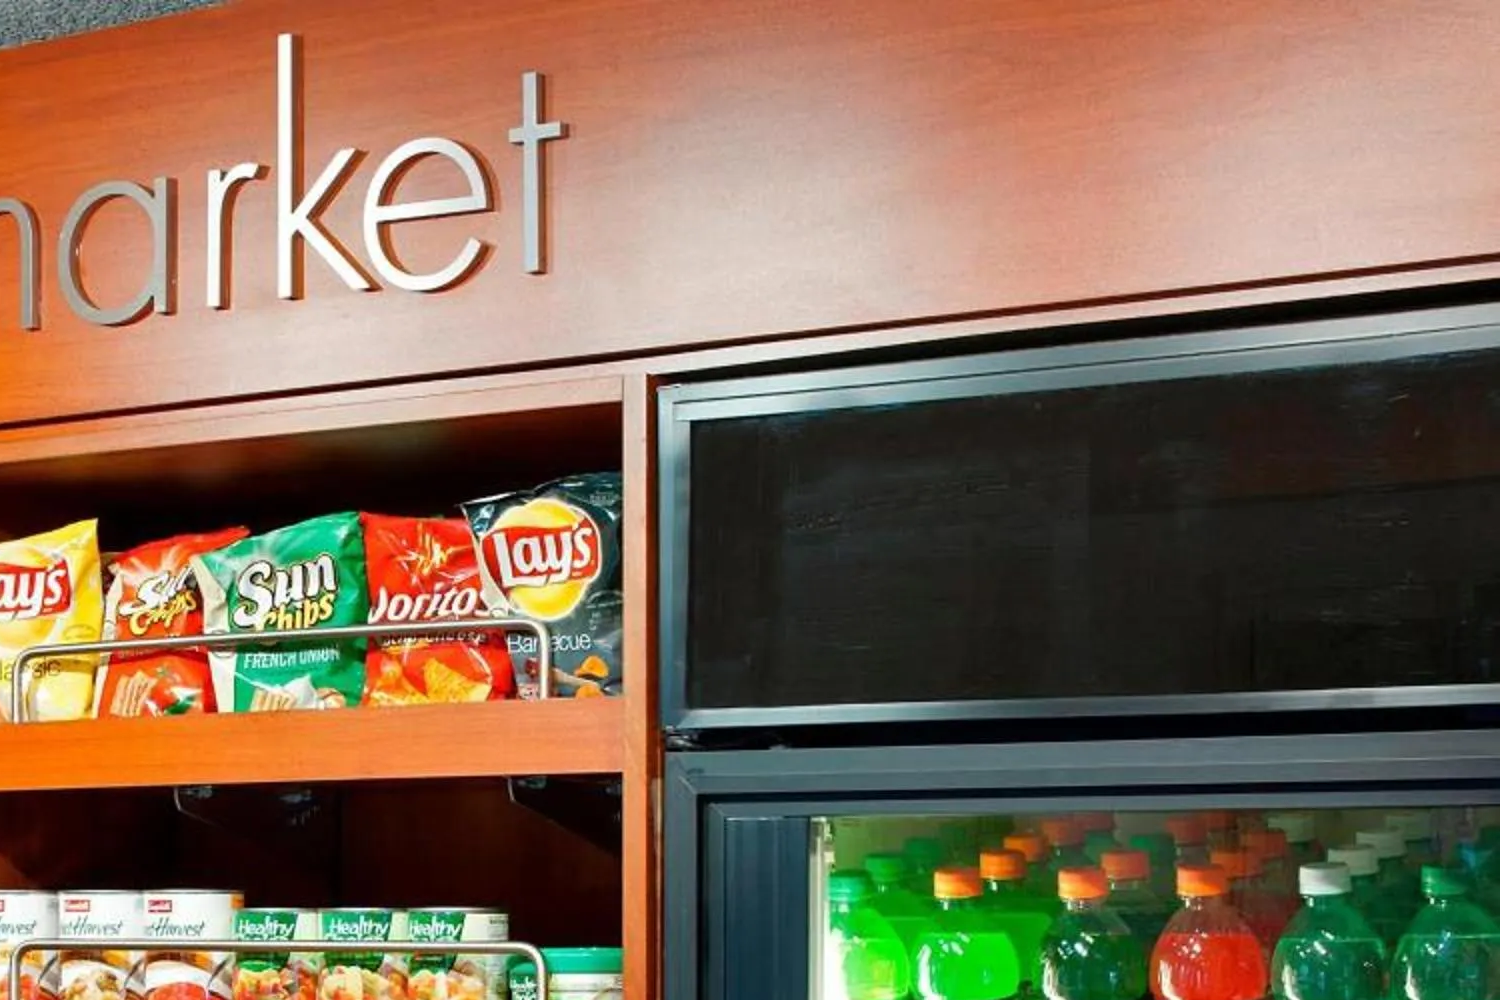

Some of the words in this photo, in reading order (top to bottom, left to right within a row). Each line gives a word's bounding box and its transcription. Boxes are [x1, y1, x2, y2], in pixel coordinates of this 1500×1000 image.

[493, 521, 593, 588] Lay's
[233, 554, 338, 628] Sun
[244, 652, 297, 669] FRENCH
[238, 915, 295, 937] Healthy
[330, 915, 391, 938] Healthy
